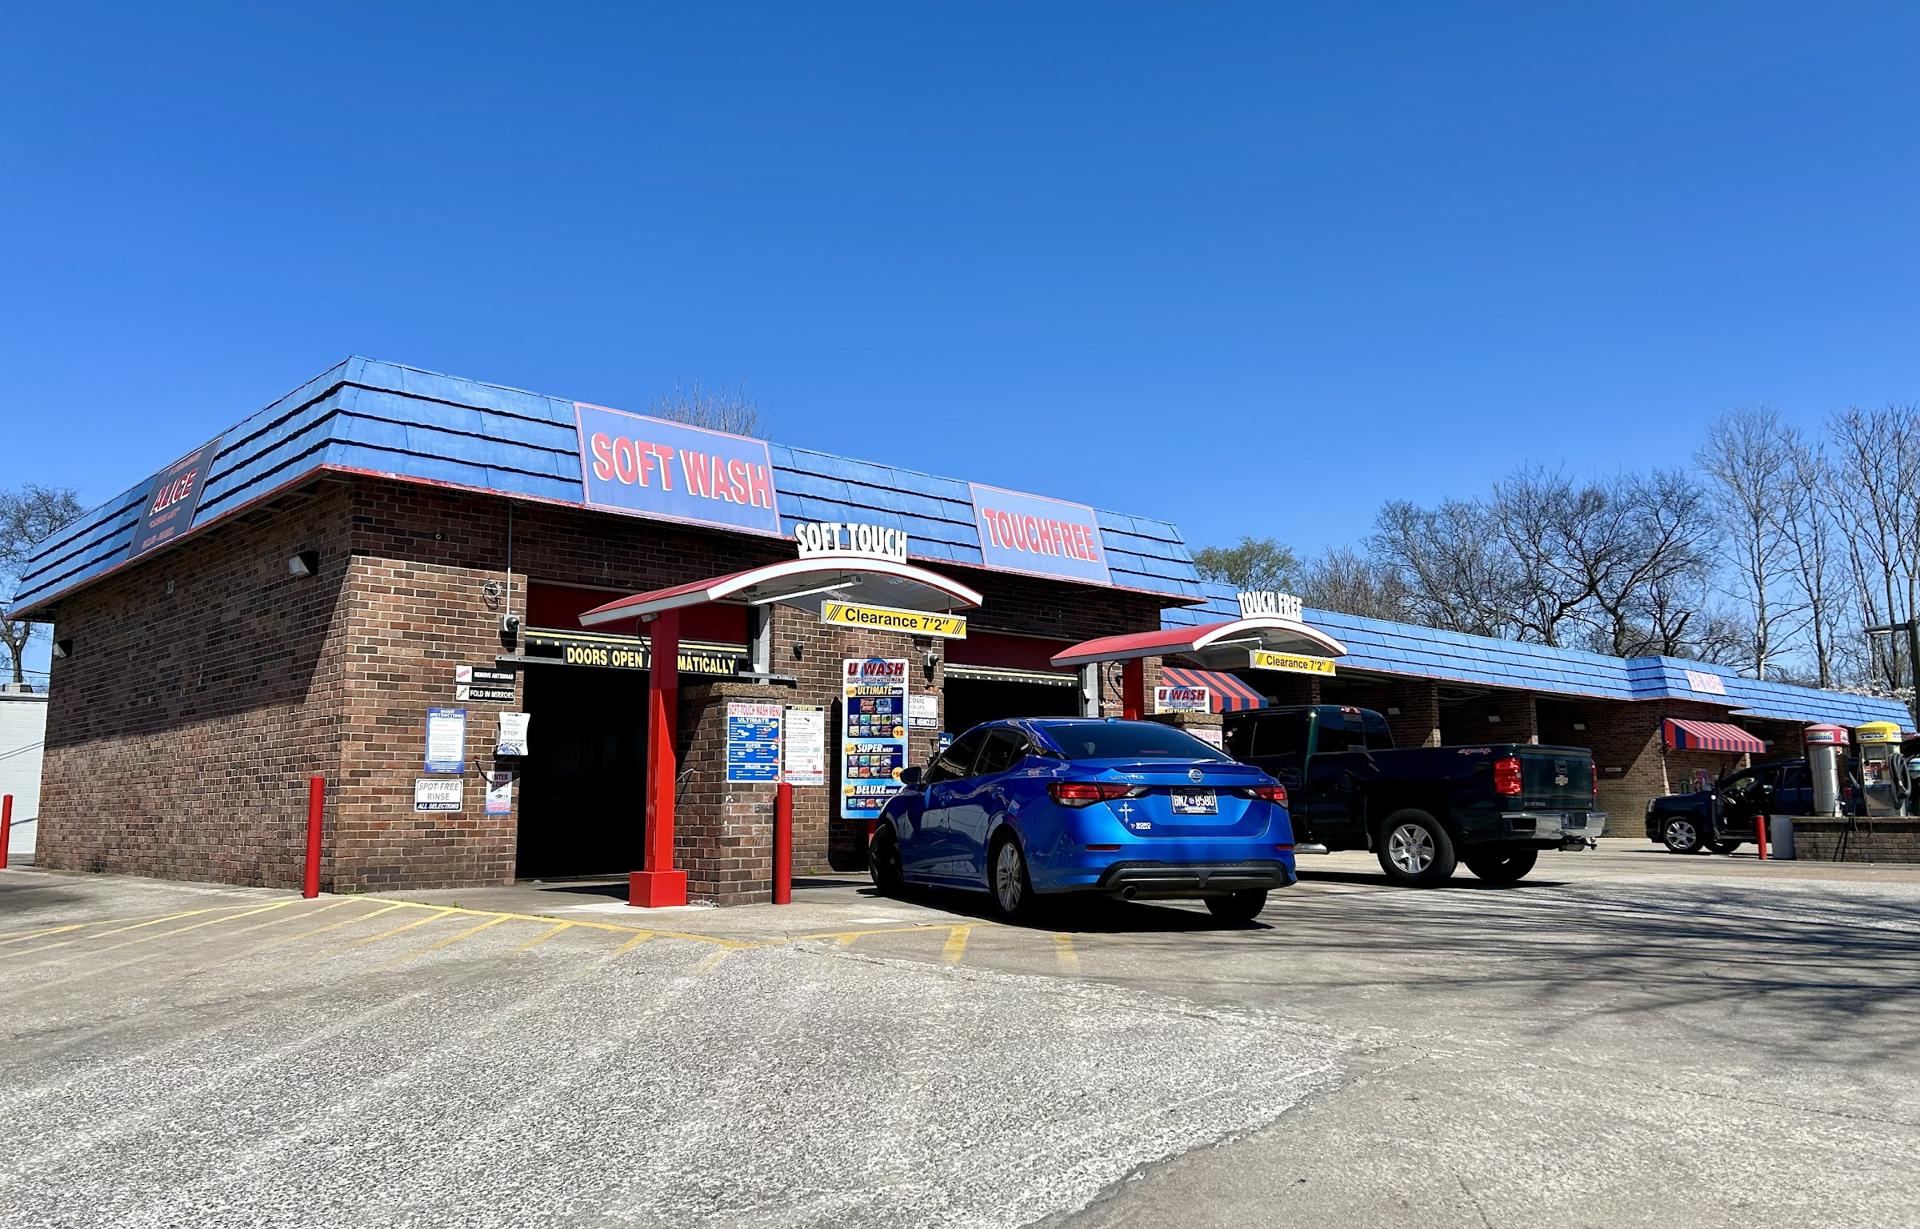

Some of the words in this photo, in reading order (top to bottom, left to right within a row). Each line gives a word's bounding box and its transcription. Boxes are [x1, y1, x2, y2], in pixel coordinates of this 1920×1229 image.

[591, 432, 673, 491] SOFT
[680, 449, 773, 510] WASH
[794, 522, 843, 551] SOFT
[845, 523, 907, 557] TOUCH
[982, 507, 1099, 562] TOUCHFREE
[1236, 591, 1275, 616] TOUCH
[1277, 595, 1303, 618] FREE
[844, 607, 918, 630] Clearance
[566, 647, 608, 666] DOORS
[612, 650, 643, 668] OPEN
[1266, 655, 1308, 669] Clearance
[847, 662, 859, 676] U
[863, 661, 905, 676] WASH
[470, 689, 484, 698] FOLD
[484, 690, 491, 698] IN
[491, 691, 515, 699] MIRRORS
[857, 685, 892, 695] ULTIMATE
[1158, 689, 1168, 700] U
[1171, 689, 1206, 701] WASH
[857, 743, 883, 753] SUPER
[418, 782, 460, 792] SPOT-FREE
[856, 785, 887, 795] DELUXE
[427, 792, 450, 801] RINSE
[417, 802, 428, 810] ALL
[427, 802, 460, 811] SELECTIONS
